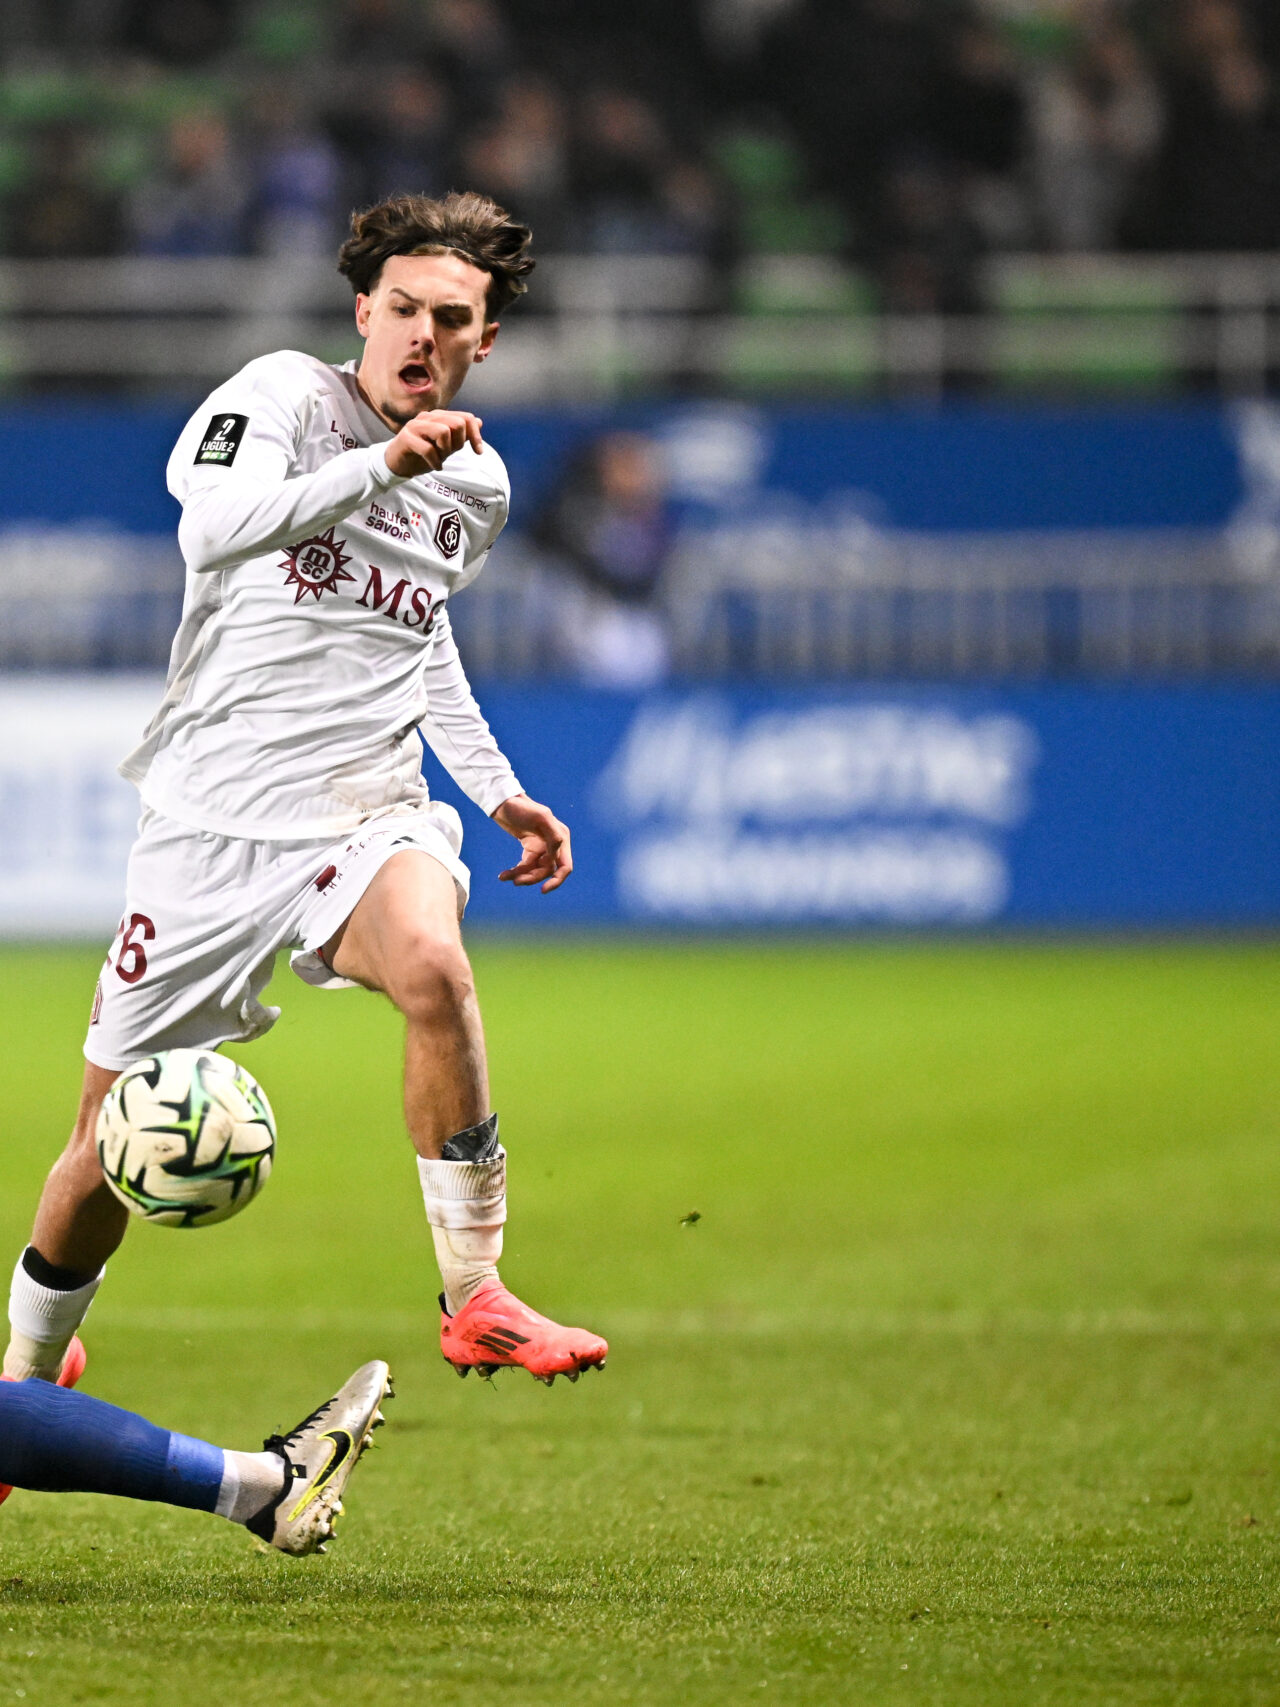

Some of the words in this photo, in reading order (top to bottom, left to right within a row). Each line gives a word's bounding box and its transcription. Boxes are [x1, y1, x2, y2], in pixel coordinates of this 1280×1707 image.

[213, 418, 236, 441] 2
[201, 440, 228, 451] LIGUE
[226, 441, 236, 452] 2
[370, 501, 409, 527] haute
[365, 515, 411, 541] savoie
[107, 913, 155, 984] 6
